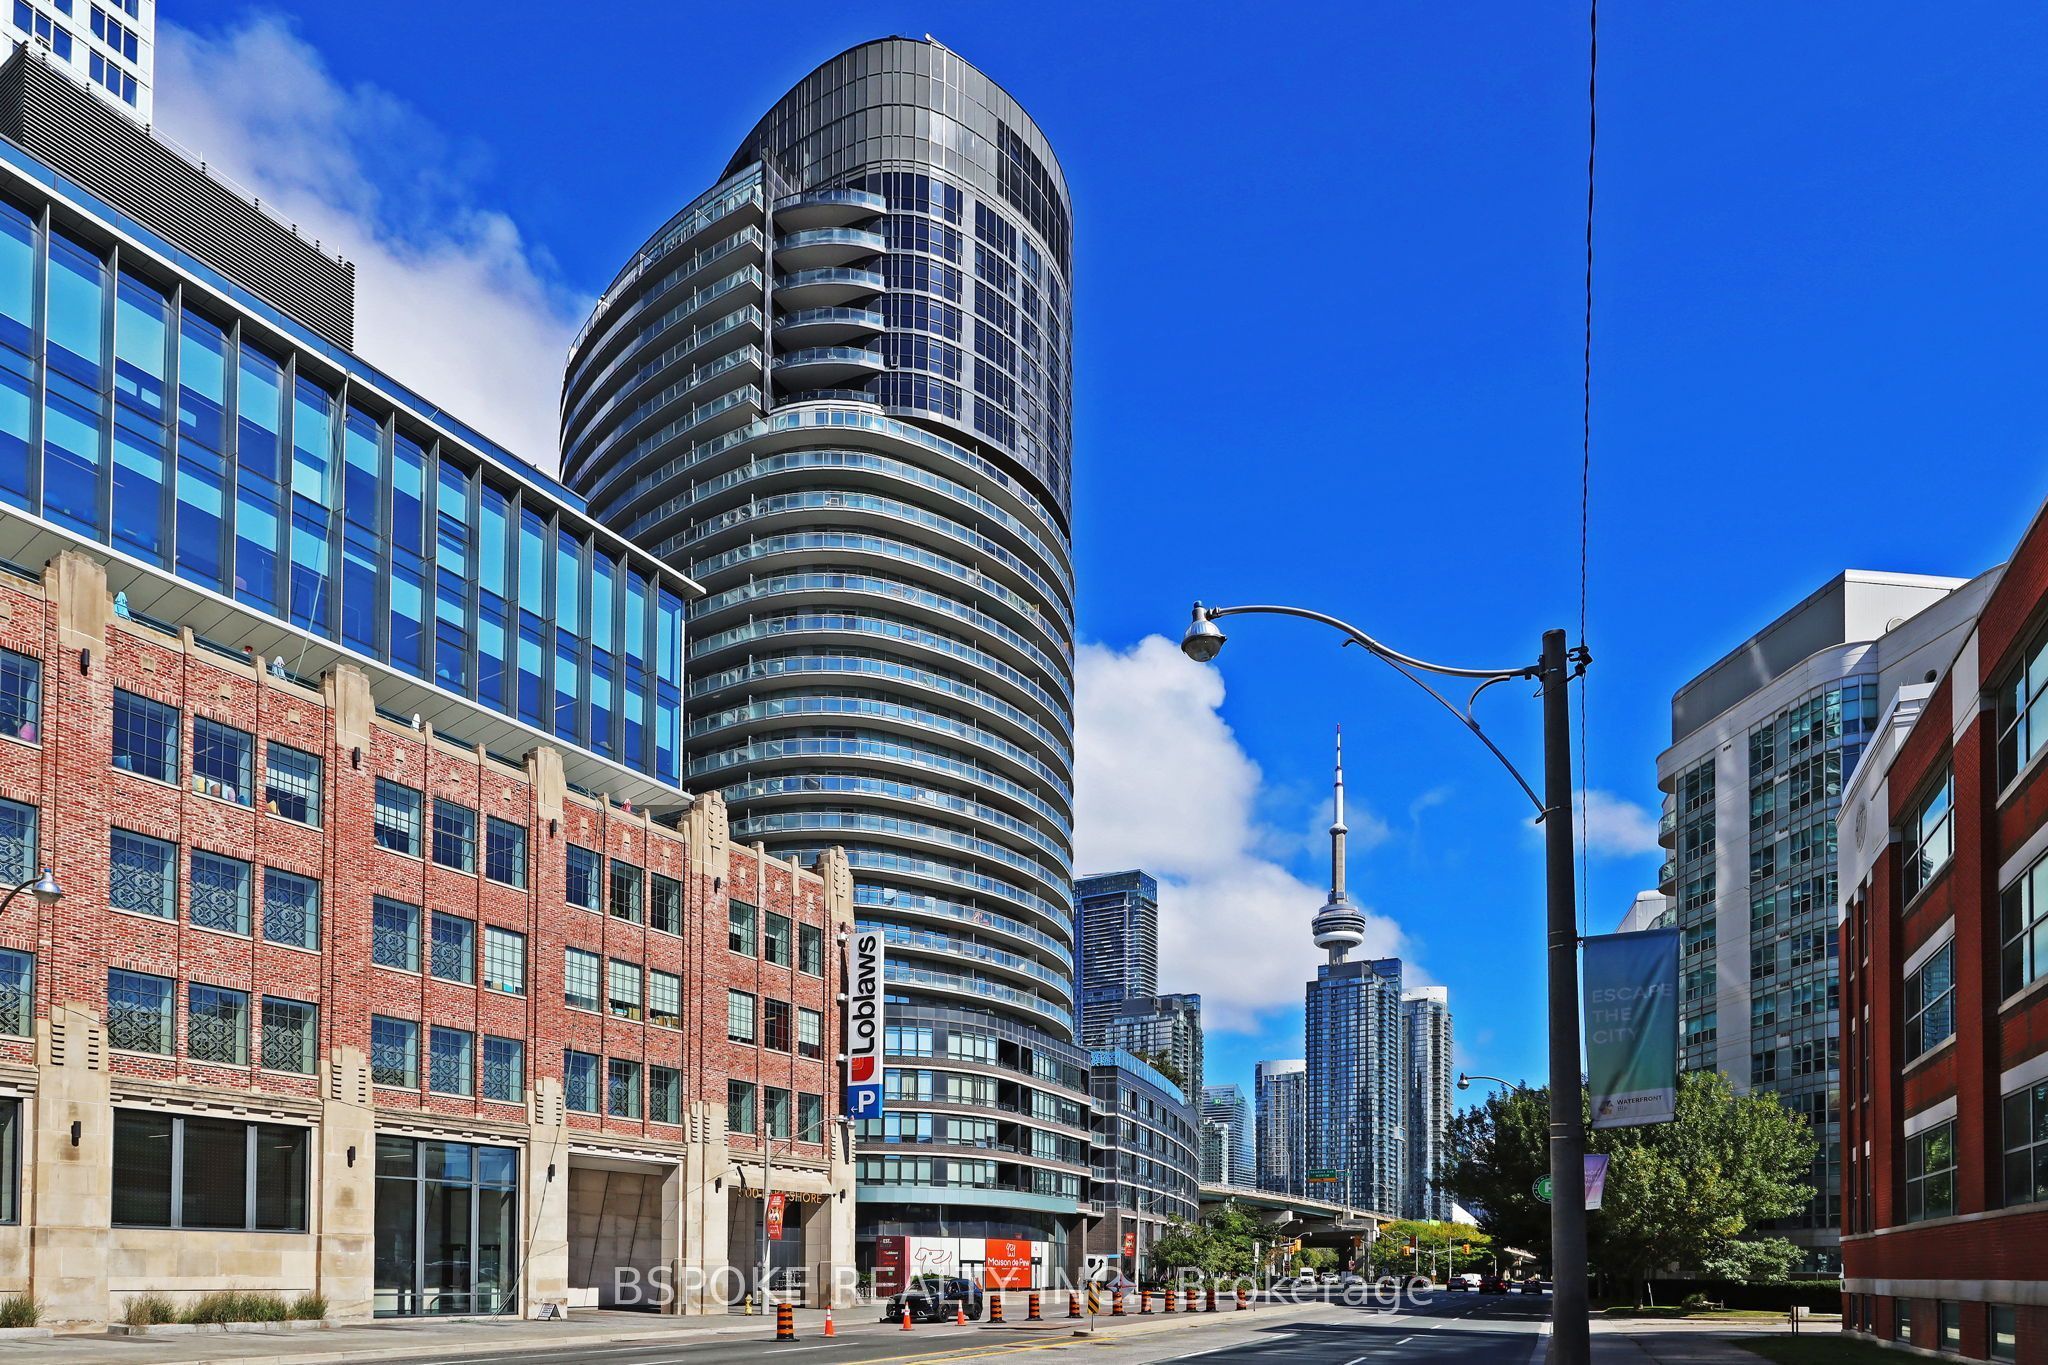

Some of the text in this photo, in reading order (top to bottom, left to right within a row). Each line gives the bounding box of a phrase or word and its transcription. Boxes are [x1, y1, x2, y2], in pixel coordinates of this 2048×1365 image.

[851, 935, 877, 1055] Loblaws
[1592, 983, 1674, 1004] ESCAPE
[1592, 1007, 1632, 1023] THE
[1593, 1027, 1638, 1045] CITY
[858, 1090, 876, 1113] P
[1616, 1094, 1663, 1105] WATERFRONT
[788, 1191, 822, 1204] SHORE
[987, 1257, 1012, 1267] Maison
[1011, 1258, 1019, 1267] de
